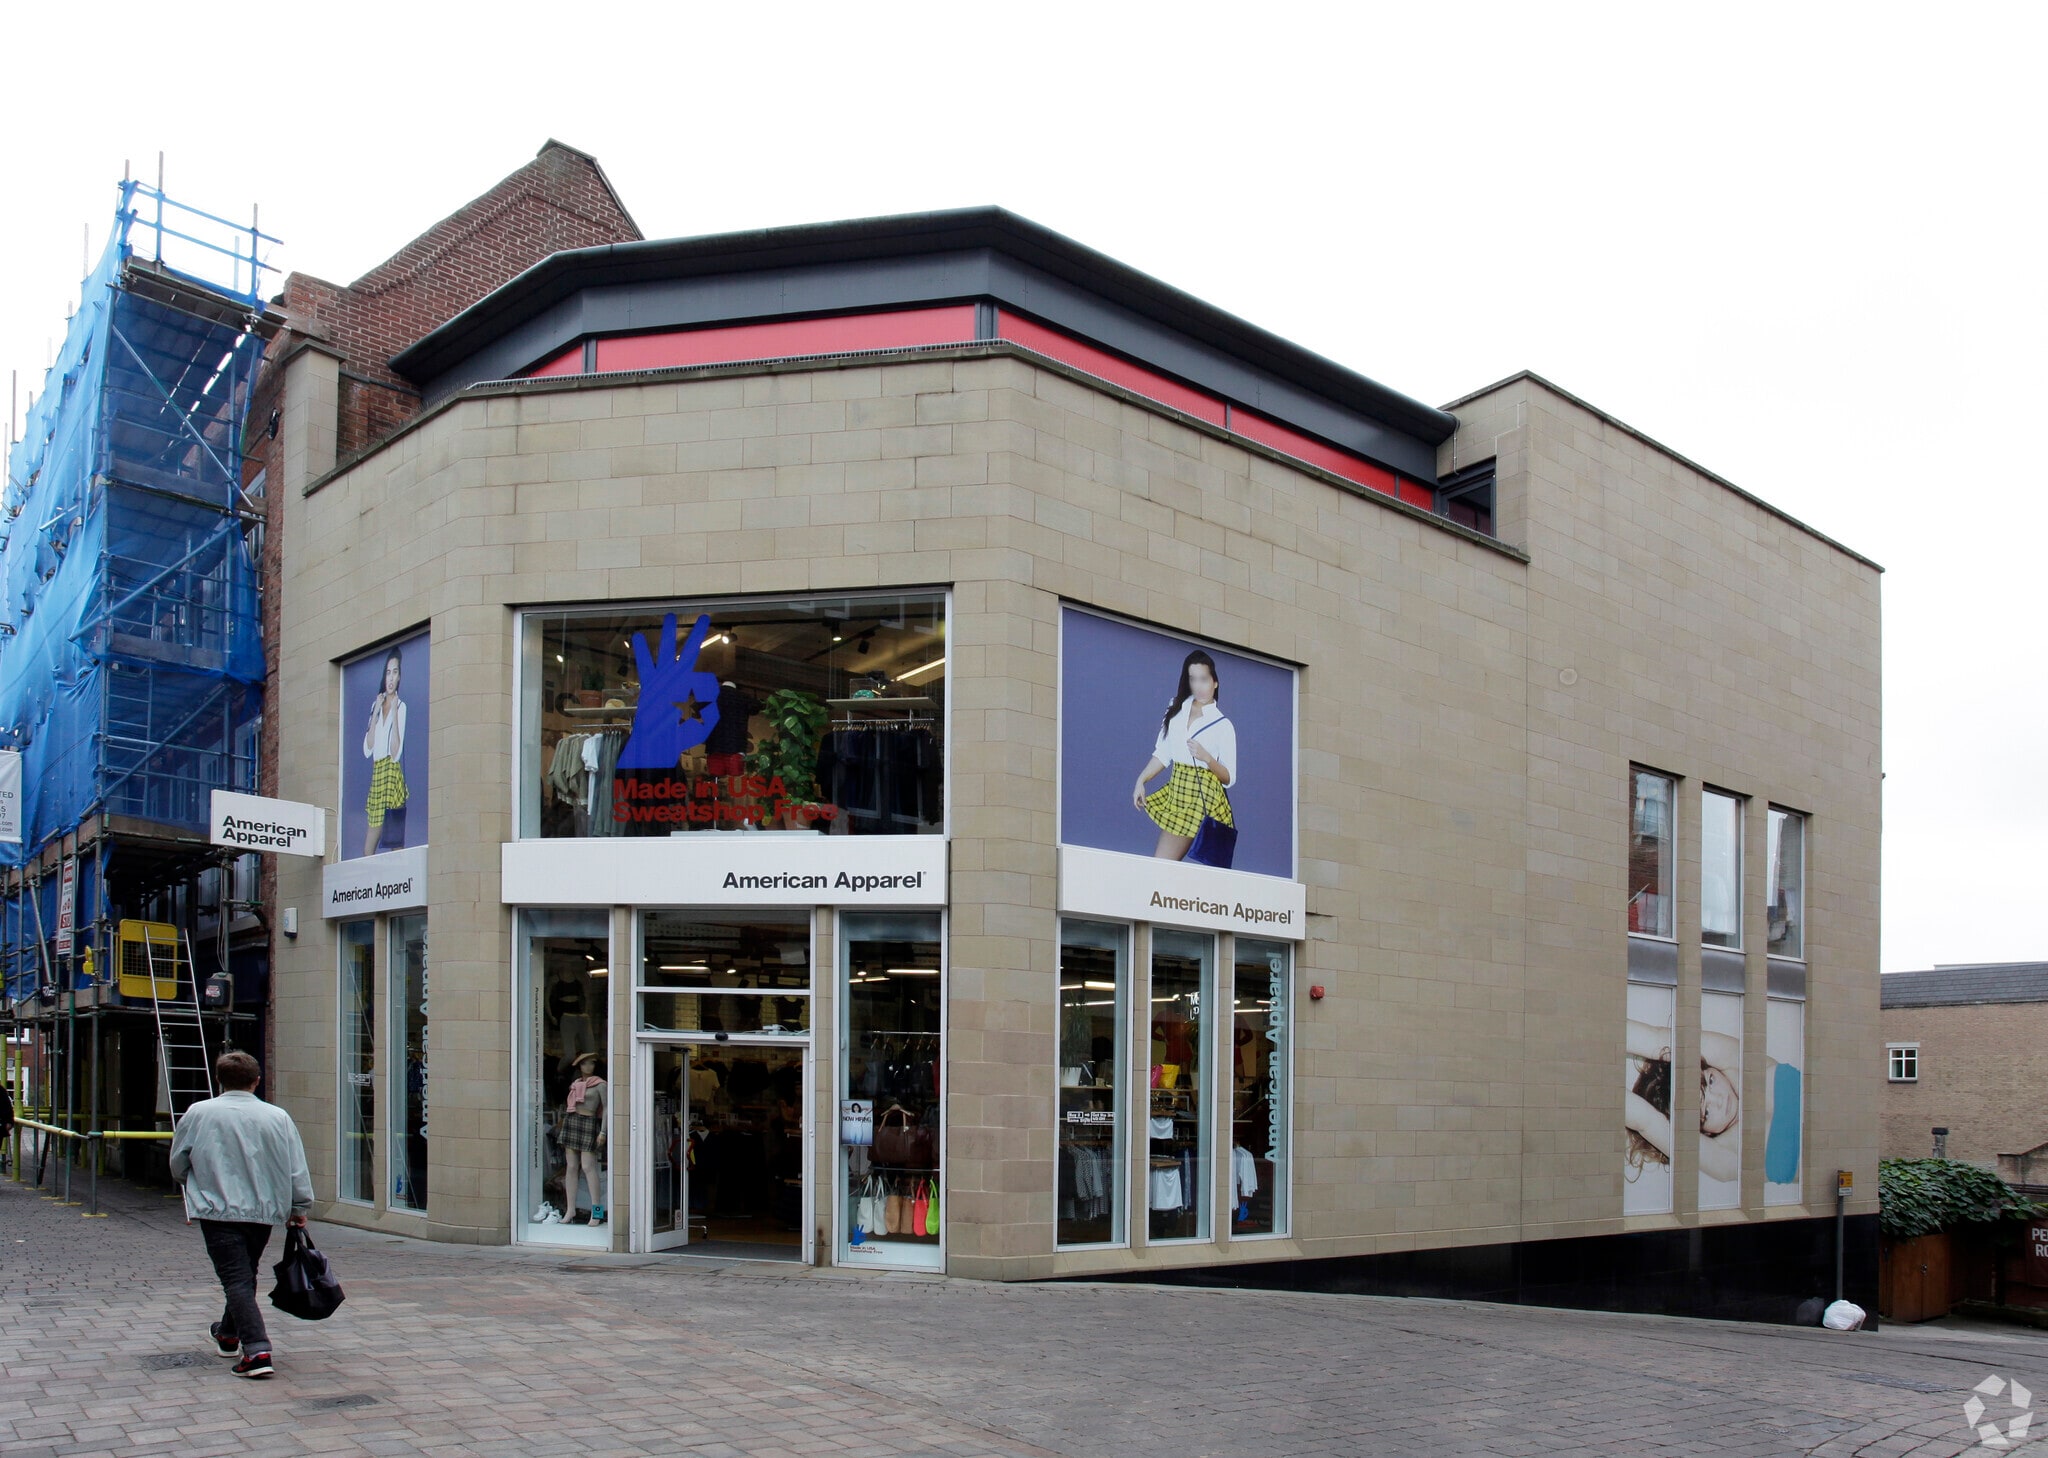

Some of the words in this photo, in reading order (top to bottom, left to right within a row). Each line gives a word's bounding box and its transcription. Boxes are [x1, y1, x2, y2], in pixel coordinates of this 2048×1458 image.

[613, 778, 687, 799] Made
[695, 777, 718, 798] in
[727, 776, 787, 798] USA
[613, 800, 765, 825] Sweatshop
[774, 799, 839, 821] Free
[223, 815, 307, 838] American
[223, 828, 291, 847] Apparel
[332, 887, 373, 904] American
[375, 878, 412, 899] Apparel
[722, 872, 828, 889] American
[834, 871, 922, 892] Apparel
[1150, 891, 1229, 916] American
[1233, 902, 1291, 924] Apparel
[1265, 952, 1285, 1043] Apparel
[1265, 1051, 1281, 1164] American
